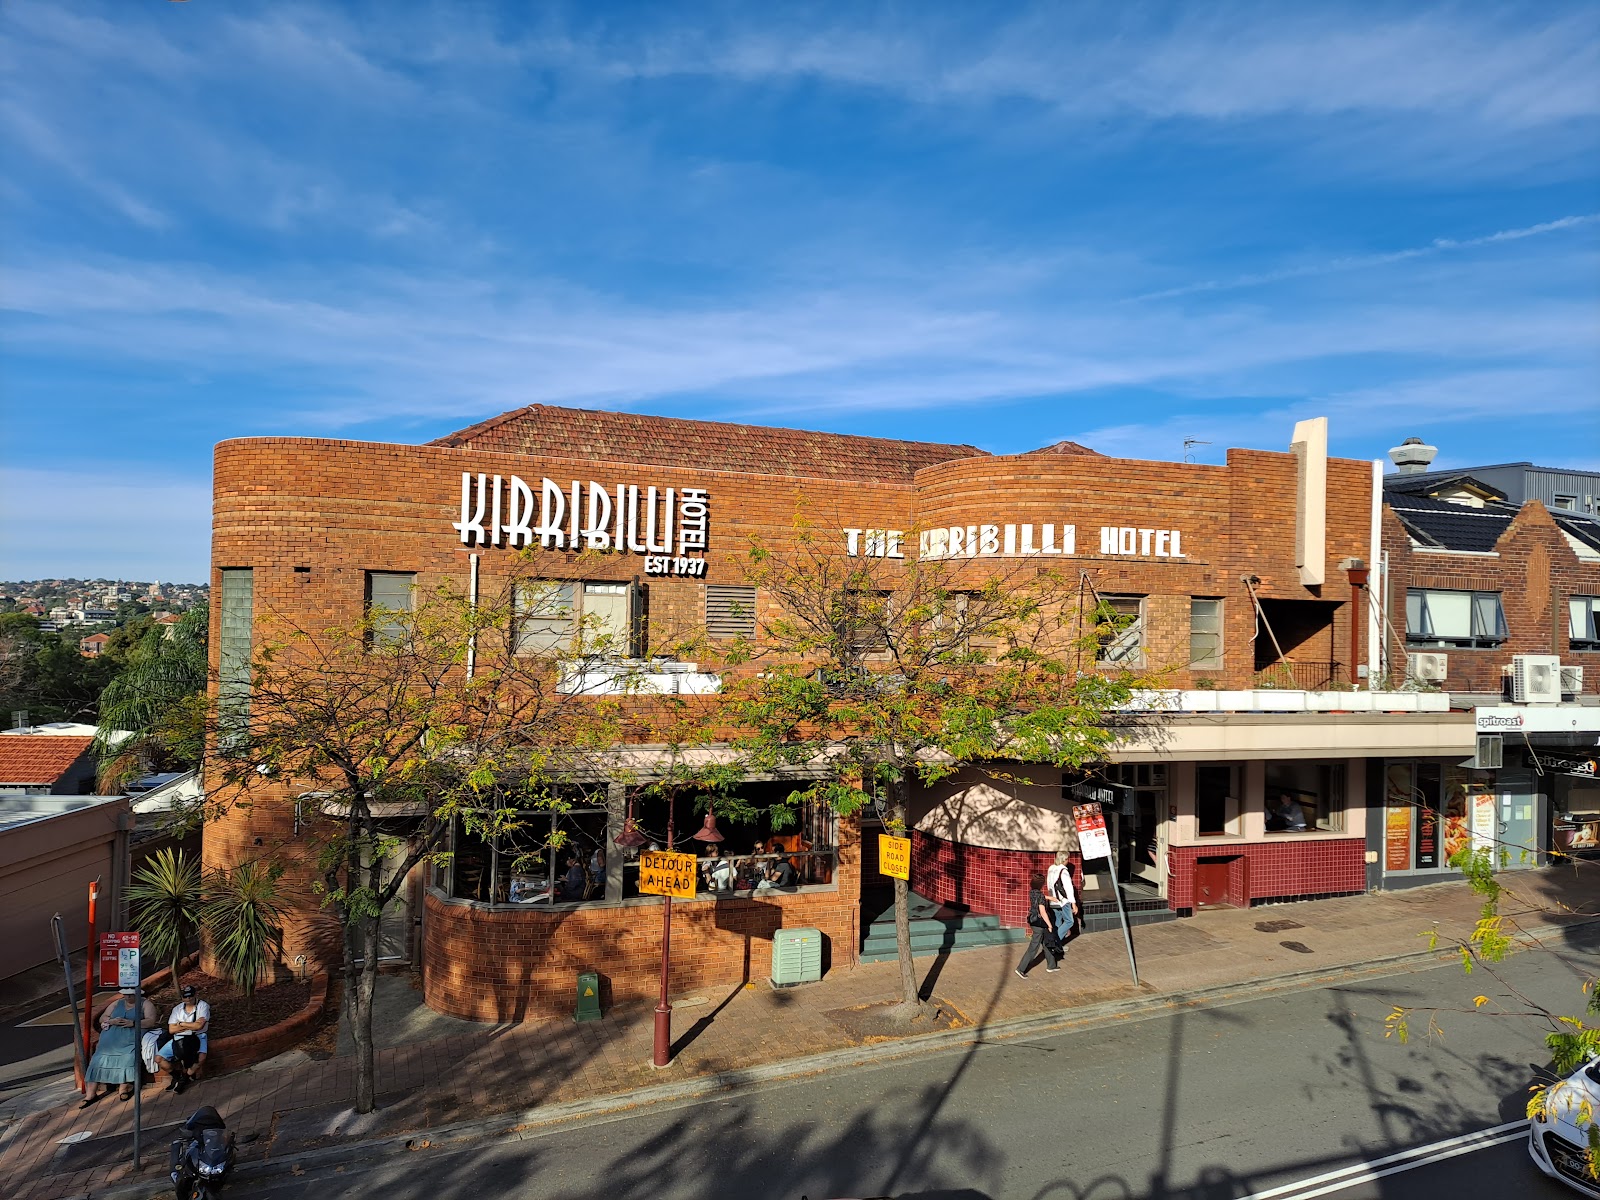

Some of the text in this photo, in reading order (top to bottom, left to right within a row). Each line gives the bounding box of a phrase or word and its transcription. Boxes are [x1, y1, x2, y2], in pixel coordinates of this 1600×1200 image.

[452, 472, 674, 554] KIRRIBILLI
[680, 488, 707, 554] HOTEL
[843, 528, 905, 558] THE
[1100, 526, 1186, 558] HOTEL
[644, 555, 705, 576] EST 1937
[1478, 715, 1522, 728] spitroast
[1528, 756, 1593, 771] spitroast
[887, 841, 903, 851] SIDE
[645, 856, 692, 872] DETOUR
[886, 852, 904, 862] ROAD
[883, 861, 907, 873] CLOSED
[647, 875, 690, 890] AHEAD
[130, 951, 136, 959] P
